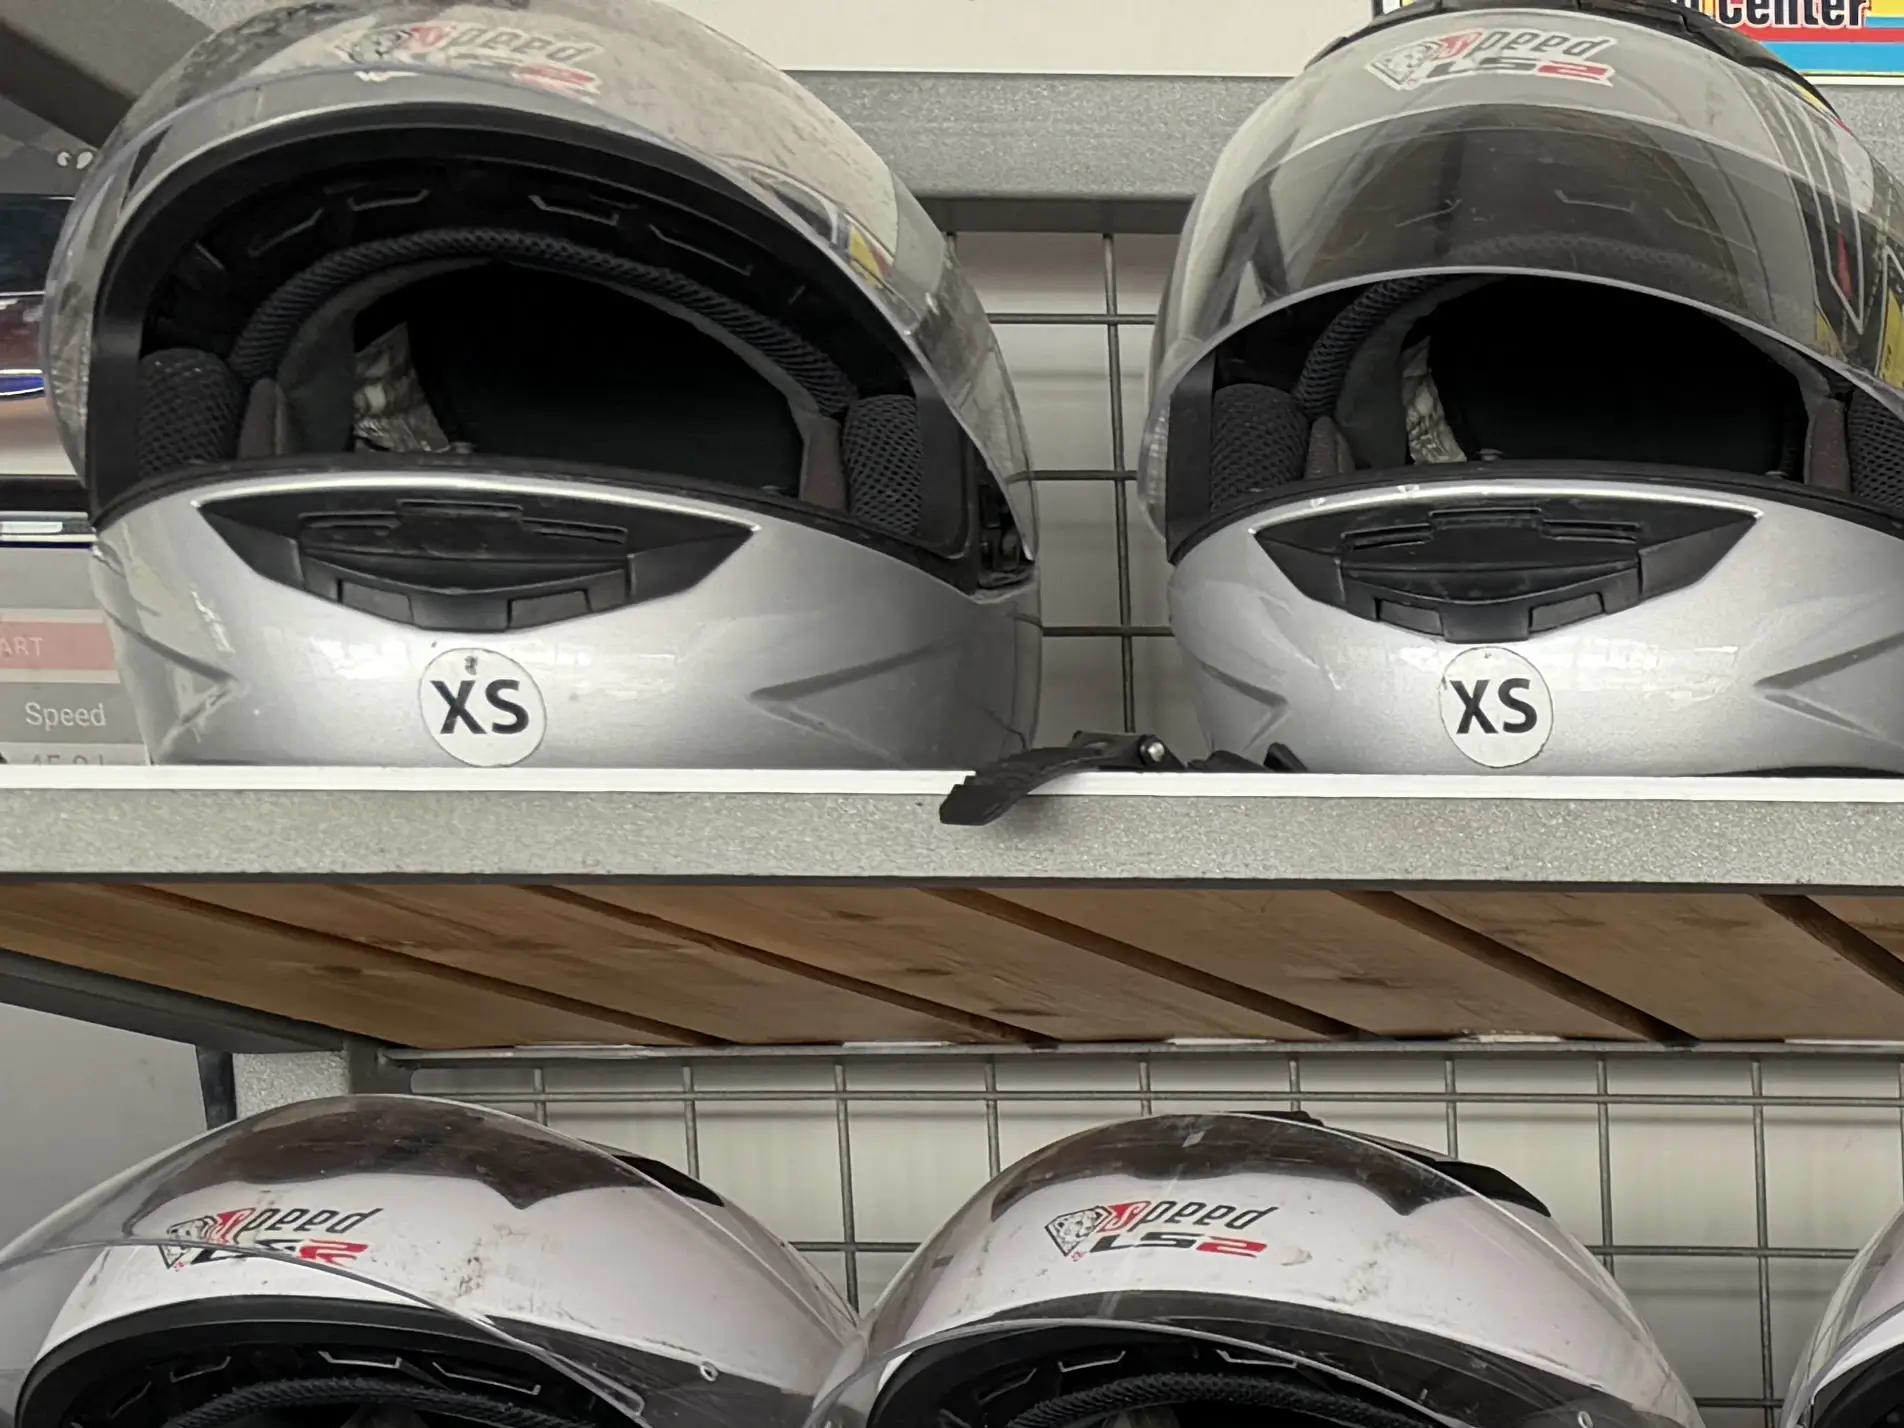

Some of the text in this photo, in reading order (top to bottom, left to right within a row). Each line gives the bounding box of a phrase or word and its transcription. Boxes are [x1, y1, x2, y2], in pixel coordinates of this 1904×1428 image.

[25, 702, 107, 731] Speed
[432, 680, 528, 733] XS
[1451, 679, 1536, 733] XS
[207, 1208, 384, 1244] Speed
[1097, 1200, 1279, 1233] Speed
[1089, 1232, 1268, 1258] LS2
